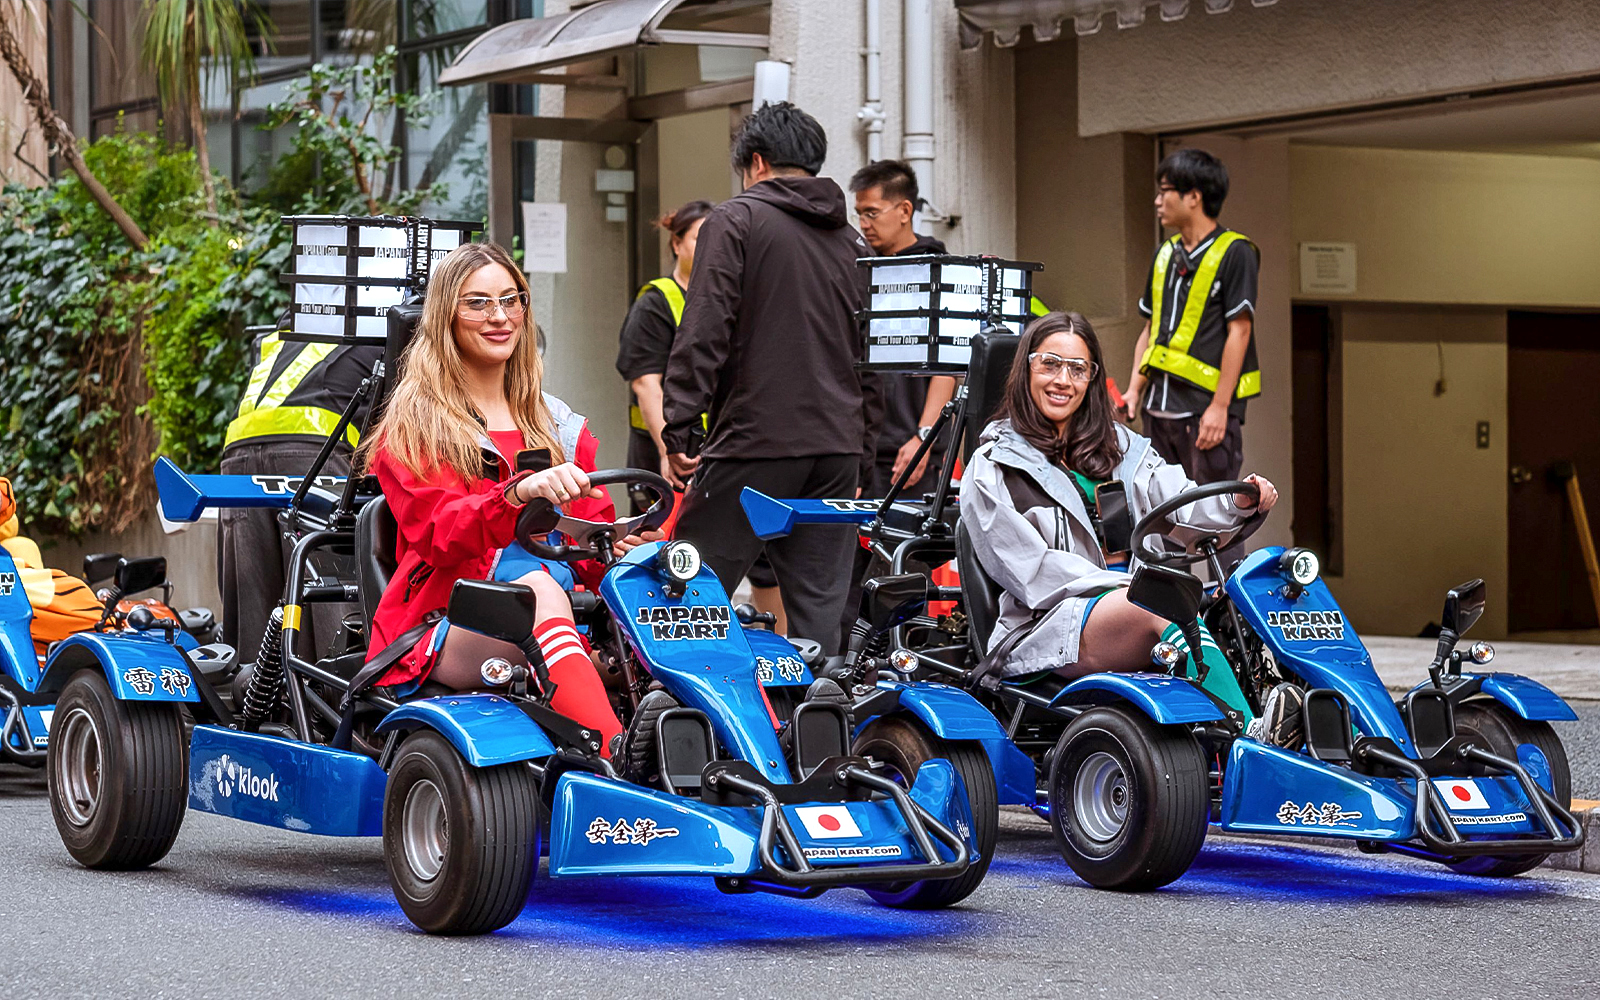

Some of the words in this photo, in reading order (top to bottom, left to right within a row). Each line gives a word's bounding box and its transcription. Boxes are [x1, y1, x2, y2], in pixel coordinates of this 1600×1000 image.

[952, 336, 971, 346] Find
[636, 606, 730, 625] JAPAN
[1267, 611, 1344, 627] JAPAN
[652, 623, 730, 641] KART
[1282, 626, 1345, 641] KART
[124, 667, 191, 697] 雷神
[238, 765, 279, 802] klook
[1276, 800, 1363, 826] 安全第一
[585, 817, 680, 846] 安全第一
[838, 846, 901, 858] KART.com
